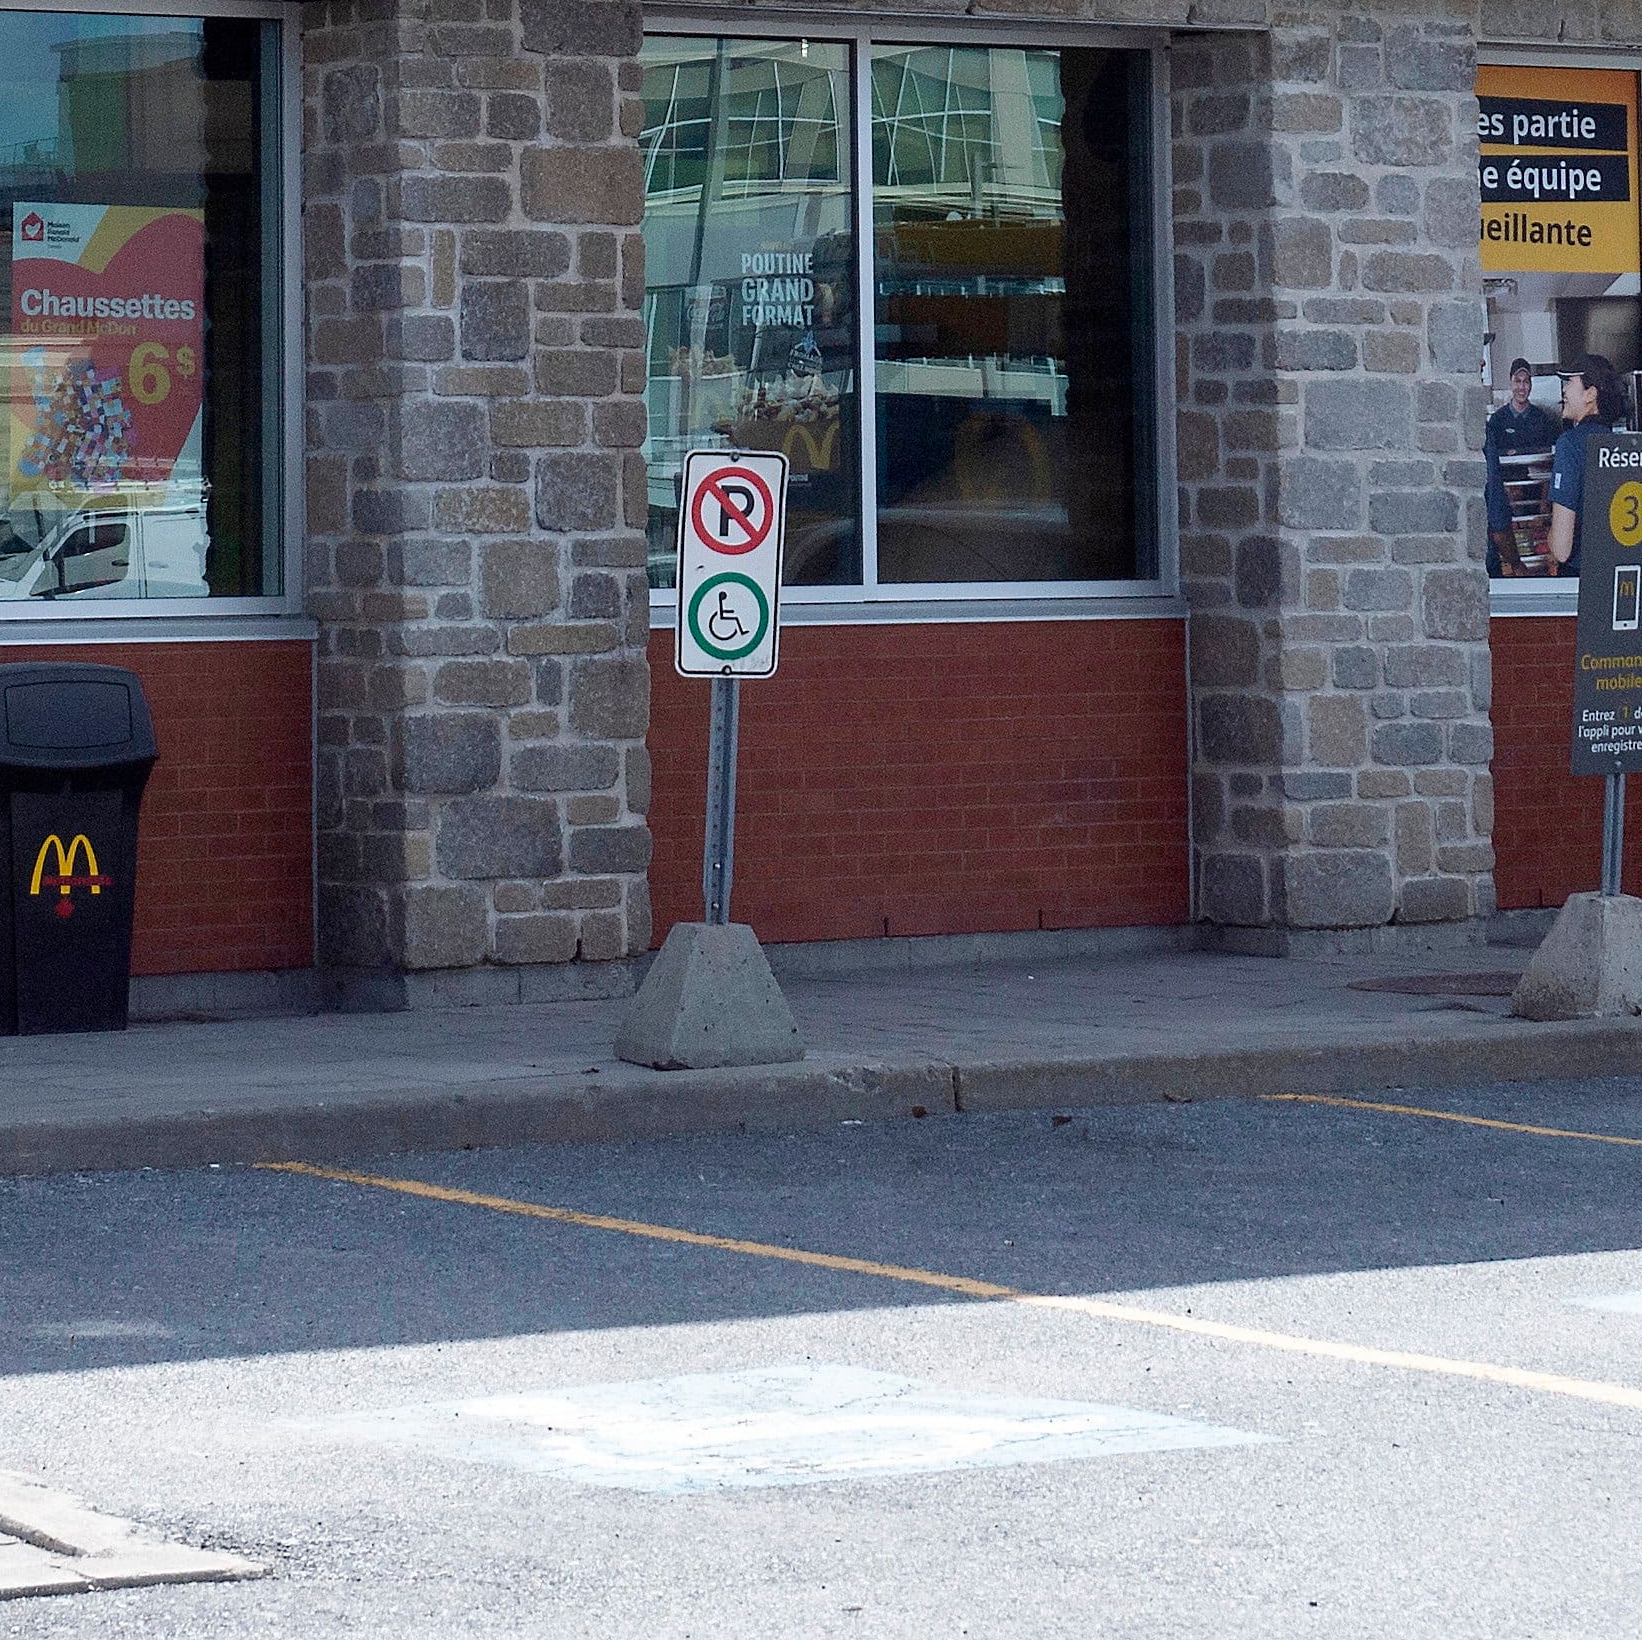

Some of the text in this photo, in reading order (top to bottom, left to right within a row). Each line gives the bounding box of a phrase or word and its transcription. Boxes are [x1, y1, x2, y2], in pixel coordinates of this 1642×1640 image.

[1513, 109, 1596, 145] partie
[1507, 159, 1602, 199] équipe
[741, 253, 813, 274] POUTINE
[20, 289, 196, 320] Chaussettes
[742, 278, 814, 303] GRAND
[742, 305, 814, 326] FORMAT
[719, 485, 755, 537] P
[1621, 495, 1640, 532] 3
[1582, 709, 1616, 722] Entrez
[1578, 724, 1610, 741] l'appli
[1611, 725, 1637, 740] pour
